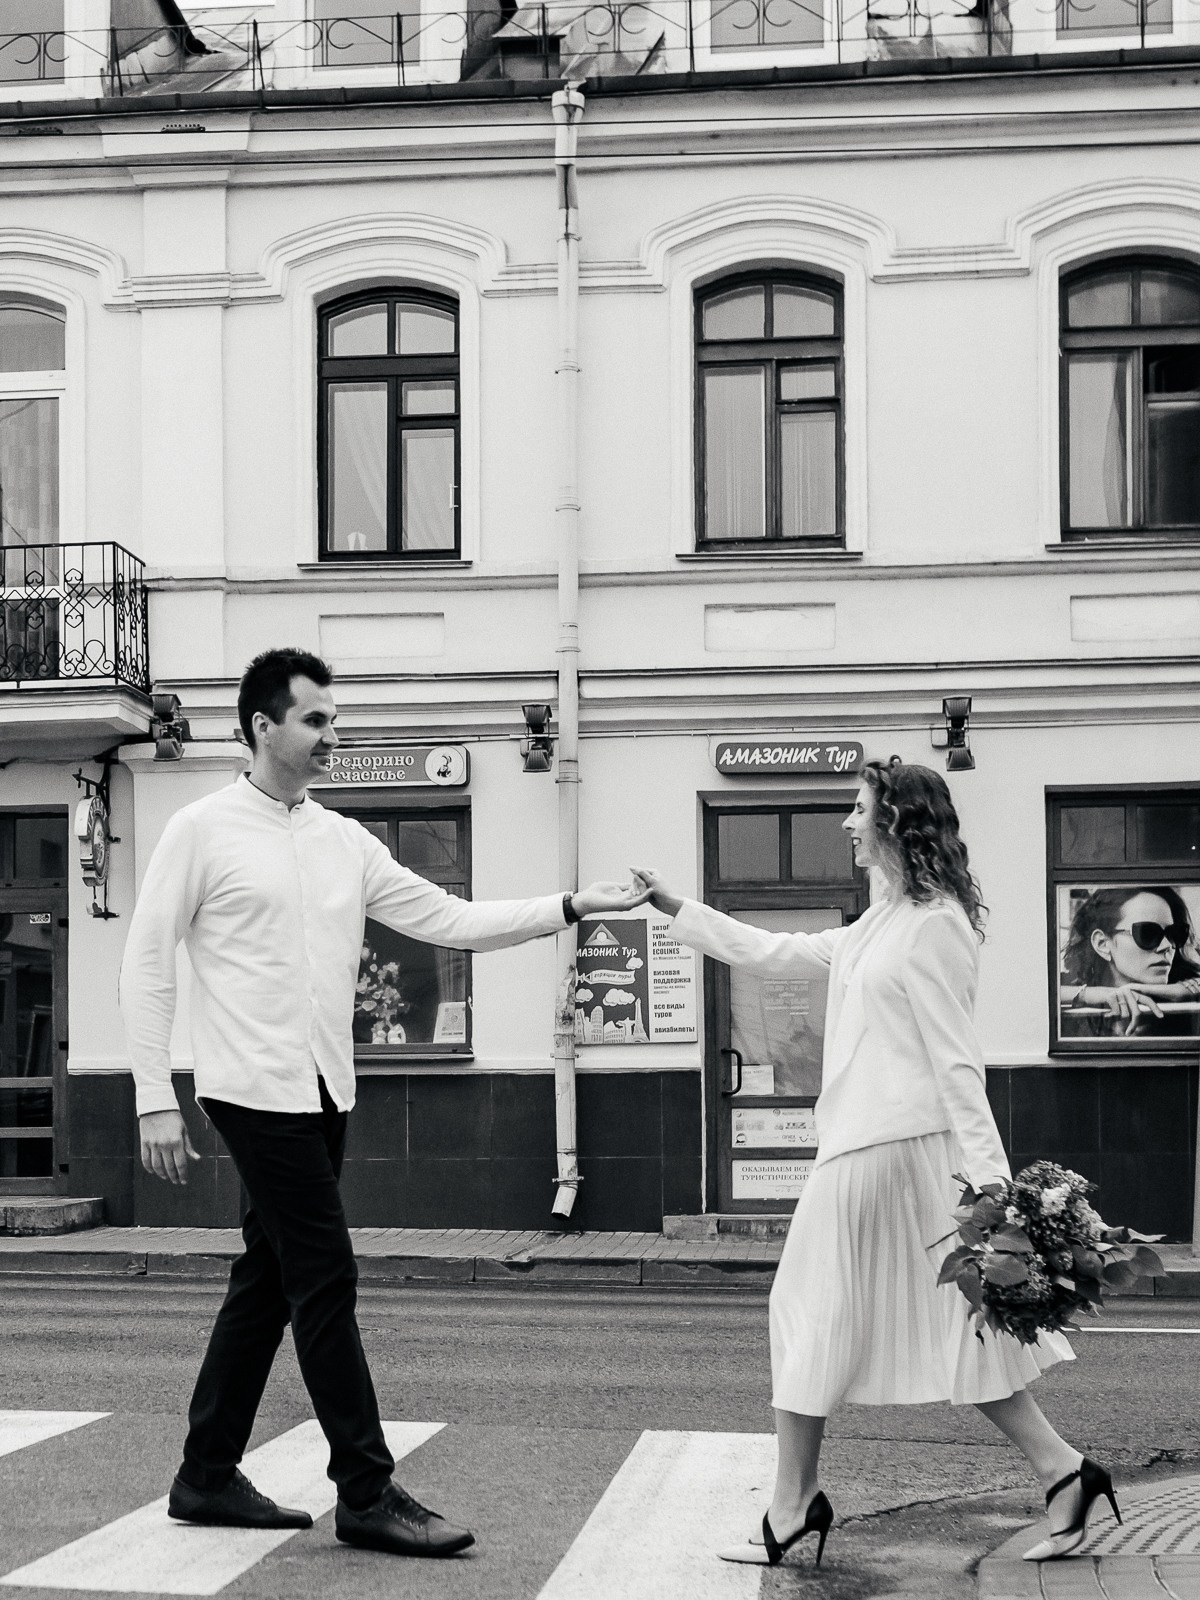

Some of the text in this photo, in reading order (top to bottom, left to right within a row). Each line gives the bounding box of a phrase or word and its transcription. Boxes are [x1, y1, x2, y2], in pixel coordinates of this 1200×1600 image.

[719, 746, 858, 772] АМАЗОНИК Тур
[330, 769, 406, 782] счастье
[576, 946, 638, 958] МАЗОНИК Тур
